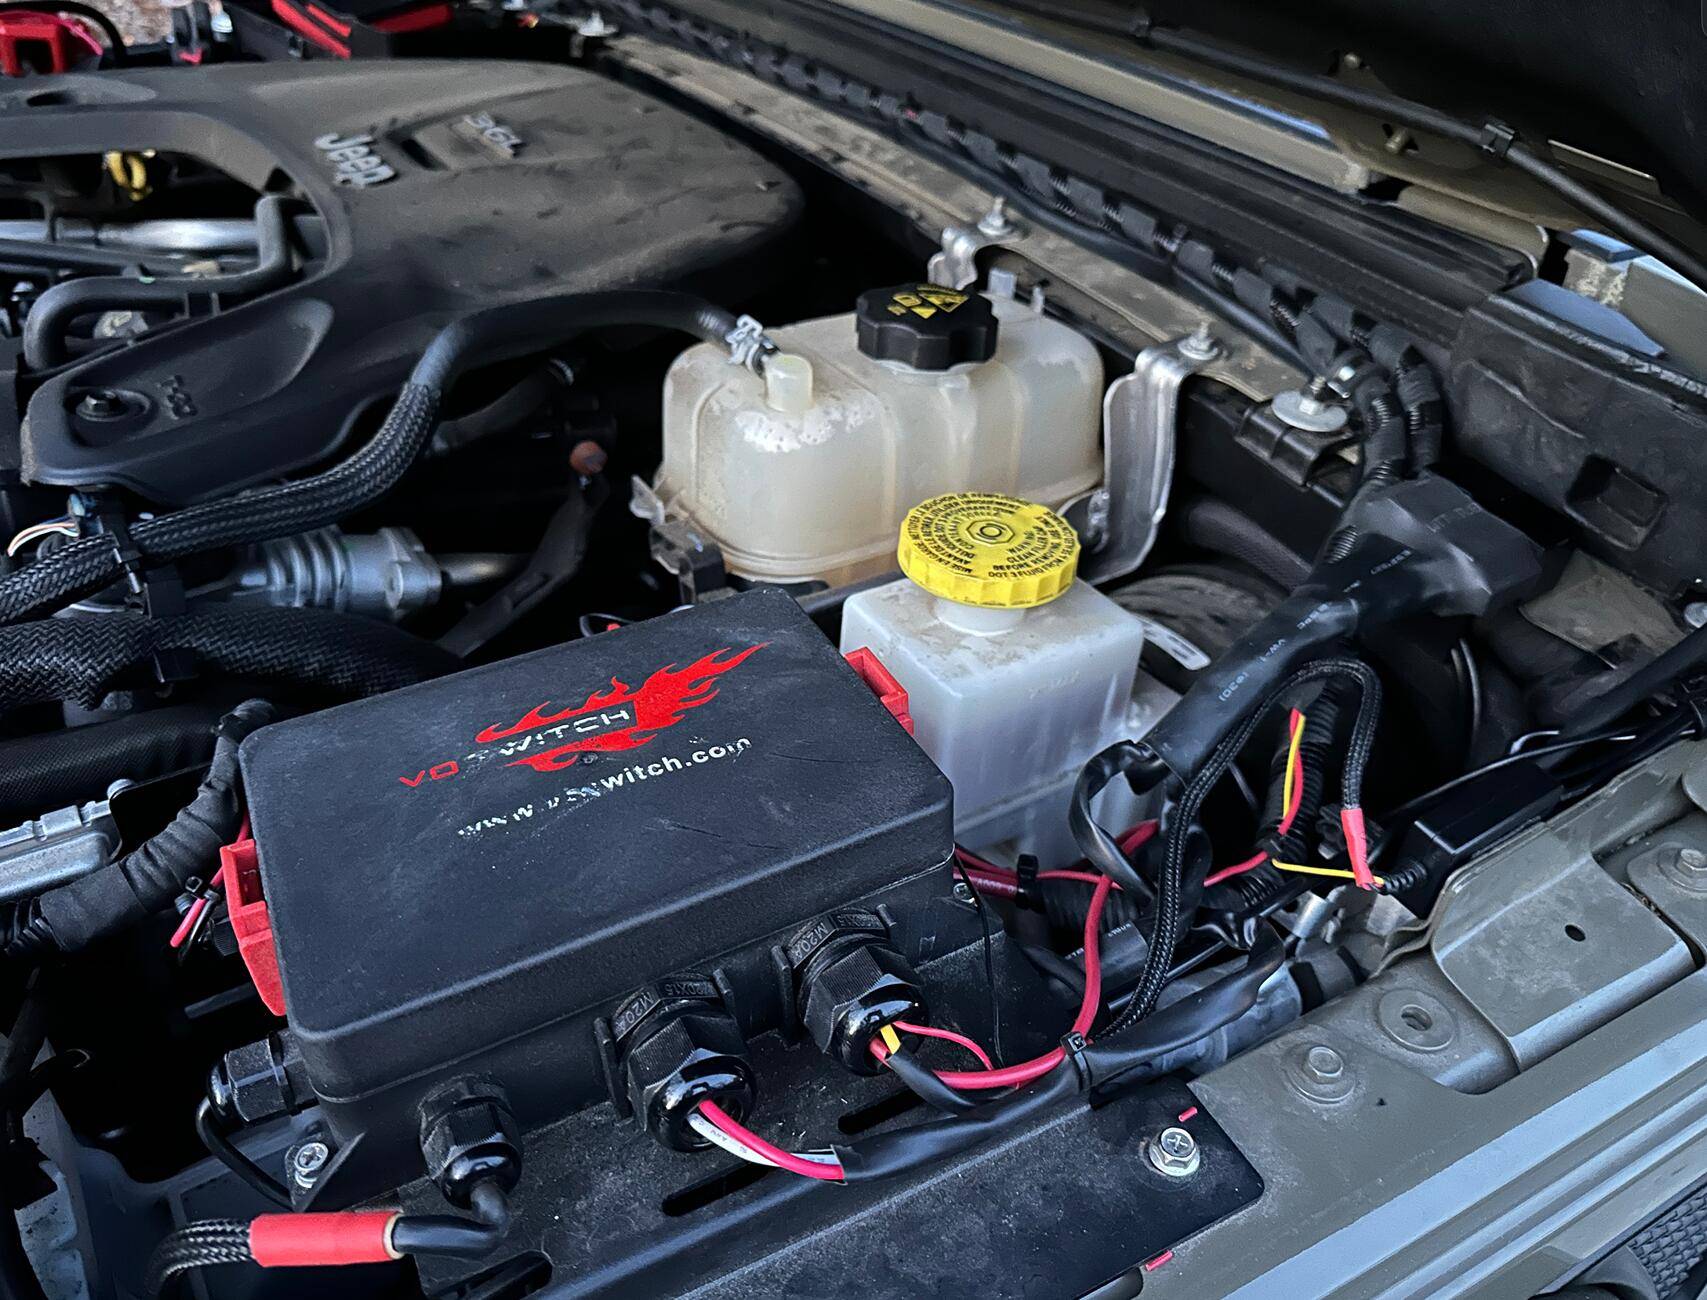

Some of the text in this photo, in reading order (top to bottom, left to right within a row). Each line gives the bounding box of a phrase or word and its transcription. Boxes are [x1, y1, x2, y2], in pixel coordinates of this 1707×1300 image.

[314, 132, 396, 189] Jeep
[940, 551, 972, 565] AVANT
[1006, 551, 1036, 564] CLEAN
[951, 563, 973, 574] MISE
[992, 562, 1032, 571] BEFORE
[988, 571, 1008, 579] DOT
[1017, 567, 1045, 578] FLUID
